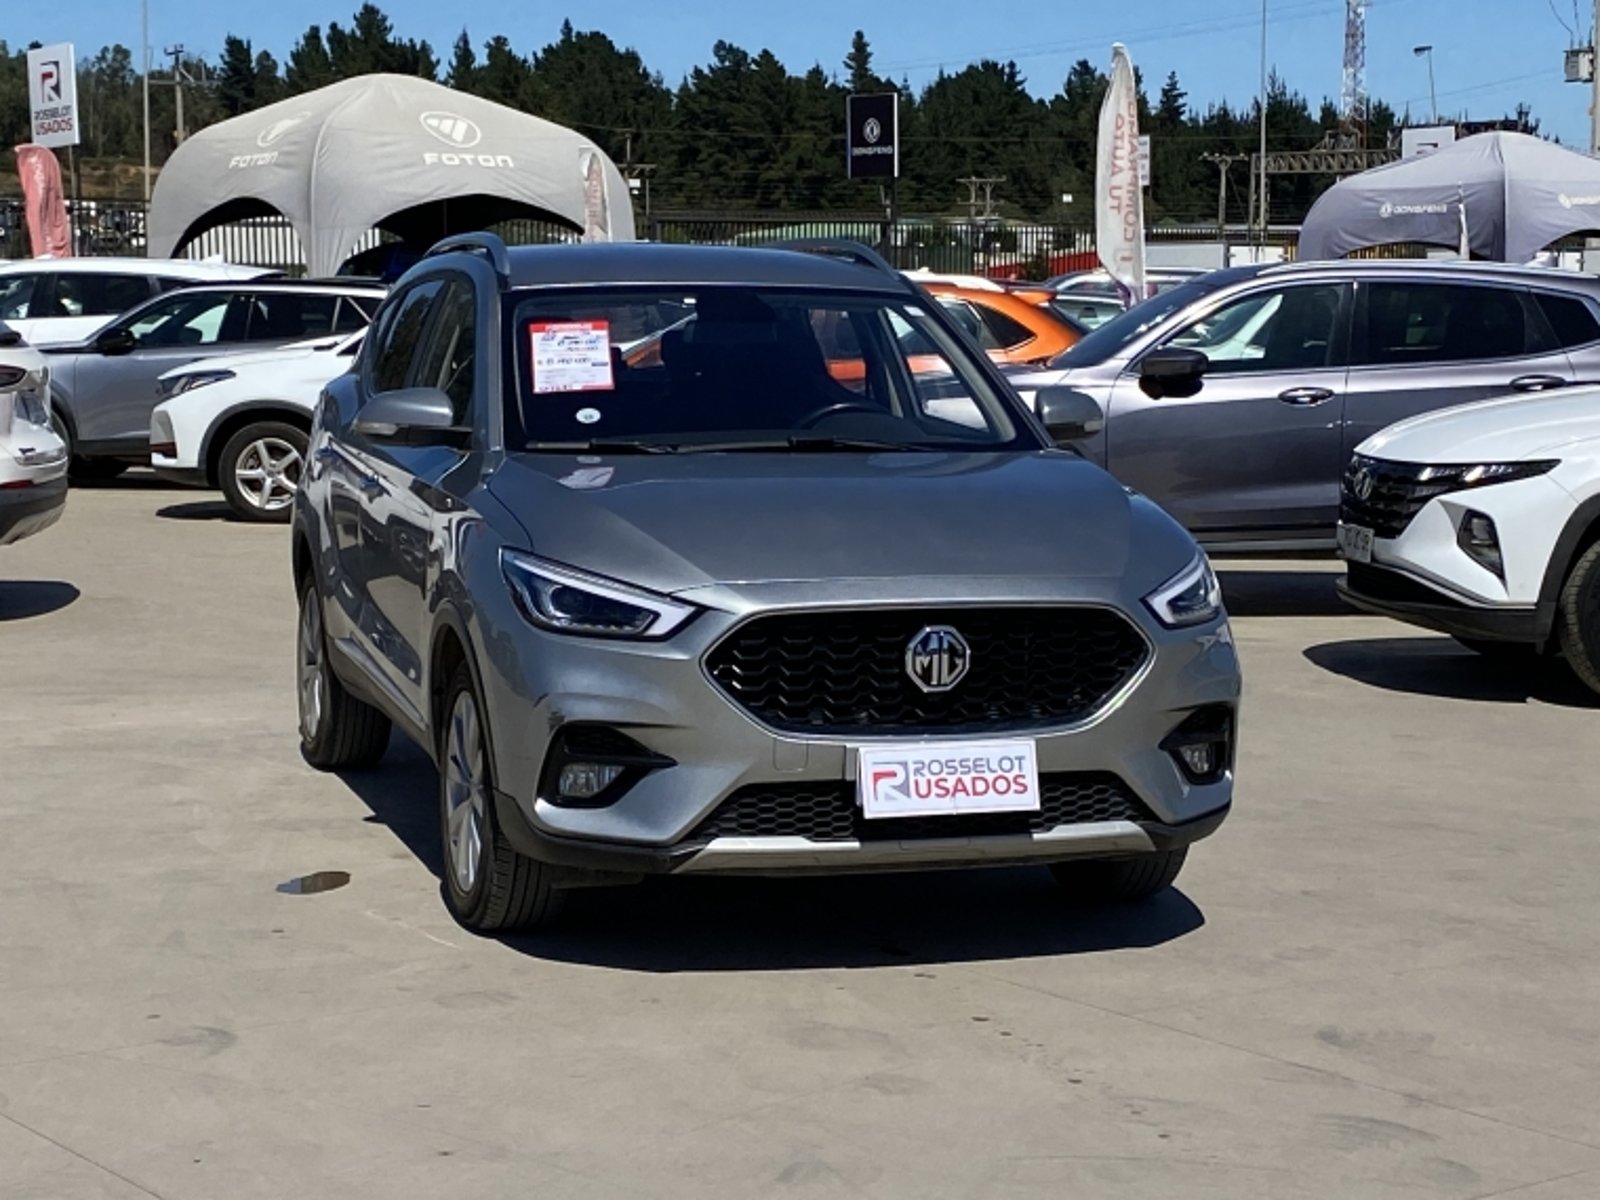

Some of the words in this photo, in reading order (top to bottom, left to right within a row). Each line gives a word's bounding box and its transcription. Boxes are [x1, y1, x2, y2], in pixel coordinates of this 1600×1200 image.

[35, 118, 73, 135] USADOS
[229, 152, 279, 168] FOTON
[422, 153, 515, 168] FOTON
[911, 631, 966, 687] MG
[912, 755, 1027, 777] ROSSELOT
[914, 774, 1029, 799] USADOS
